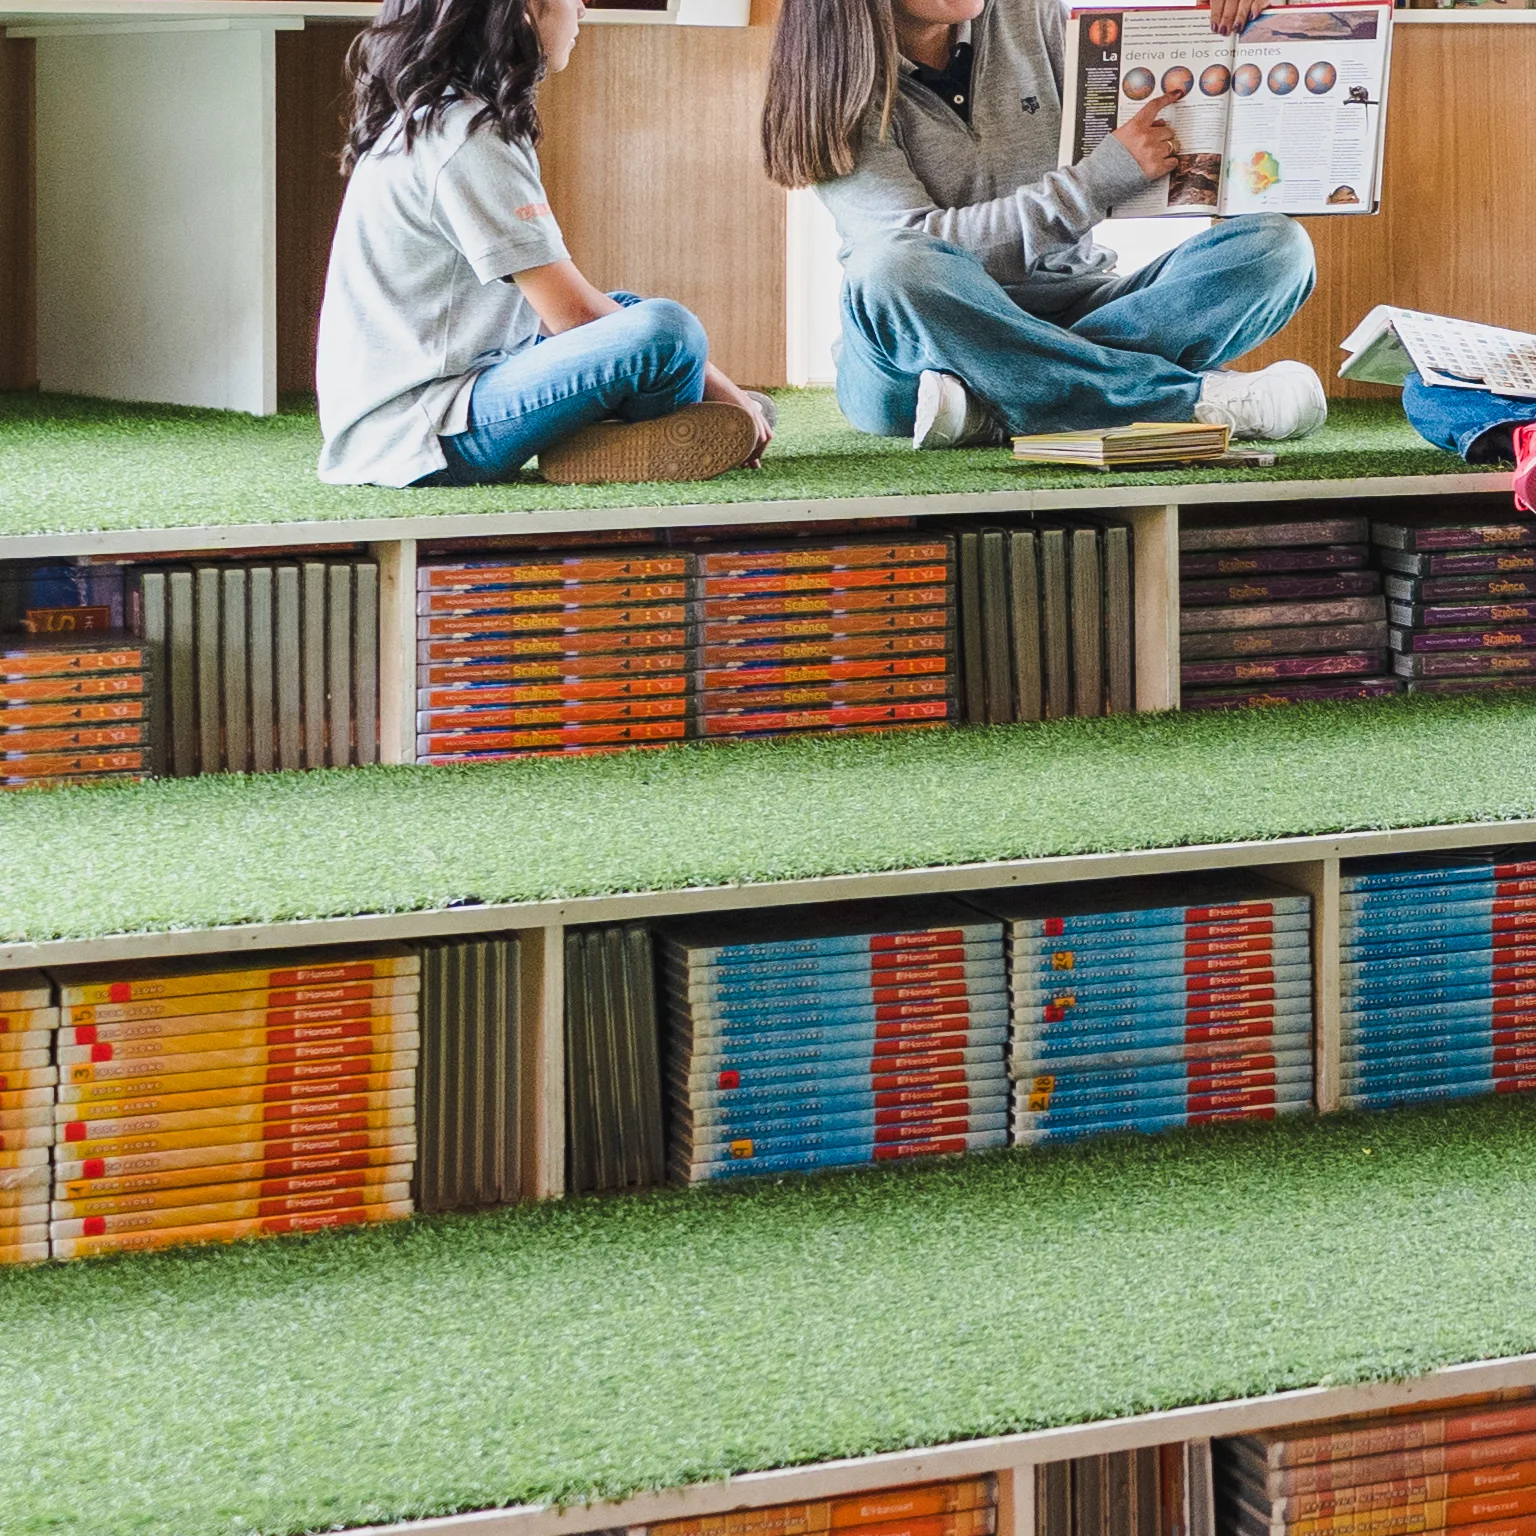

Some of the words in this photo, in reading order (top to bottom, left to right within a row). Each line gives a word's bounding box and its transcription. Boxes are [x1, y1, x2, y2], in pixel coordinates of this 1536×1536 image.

[1102, 51, 1118, 62] La
[1125, 50, 1165, 61] deriva
[1170, 49, 1187, 59] de
[1191, 47, 1210, 58] los
[513, 566, 561, 580] Science
[306, 968, 345, 979] Harcourt
[305, 987, 344, 999] Harcourt
